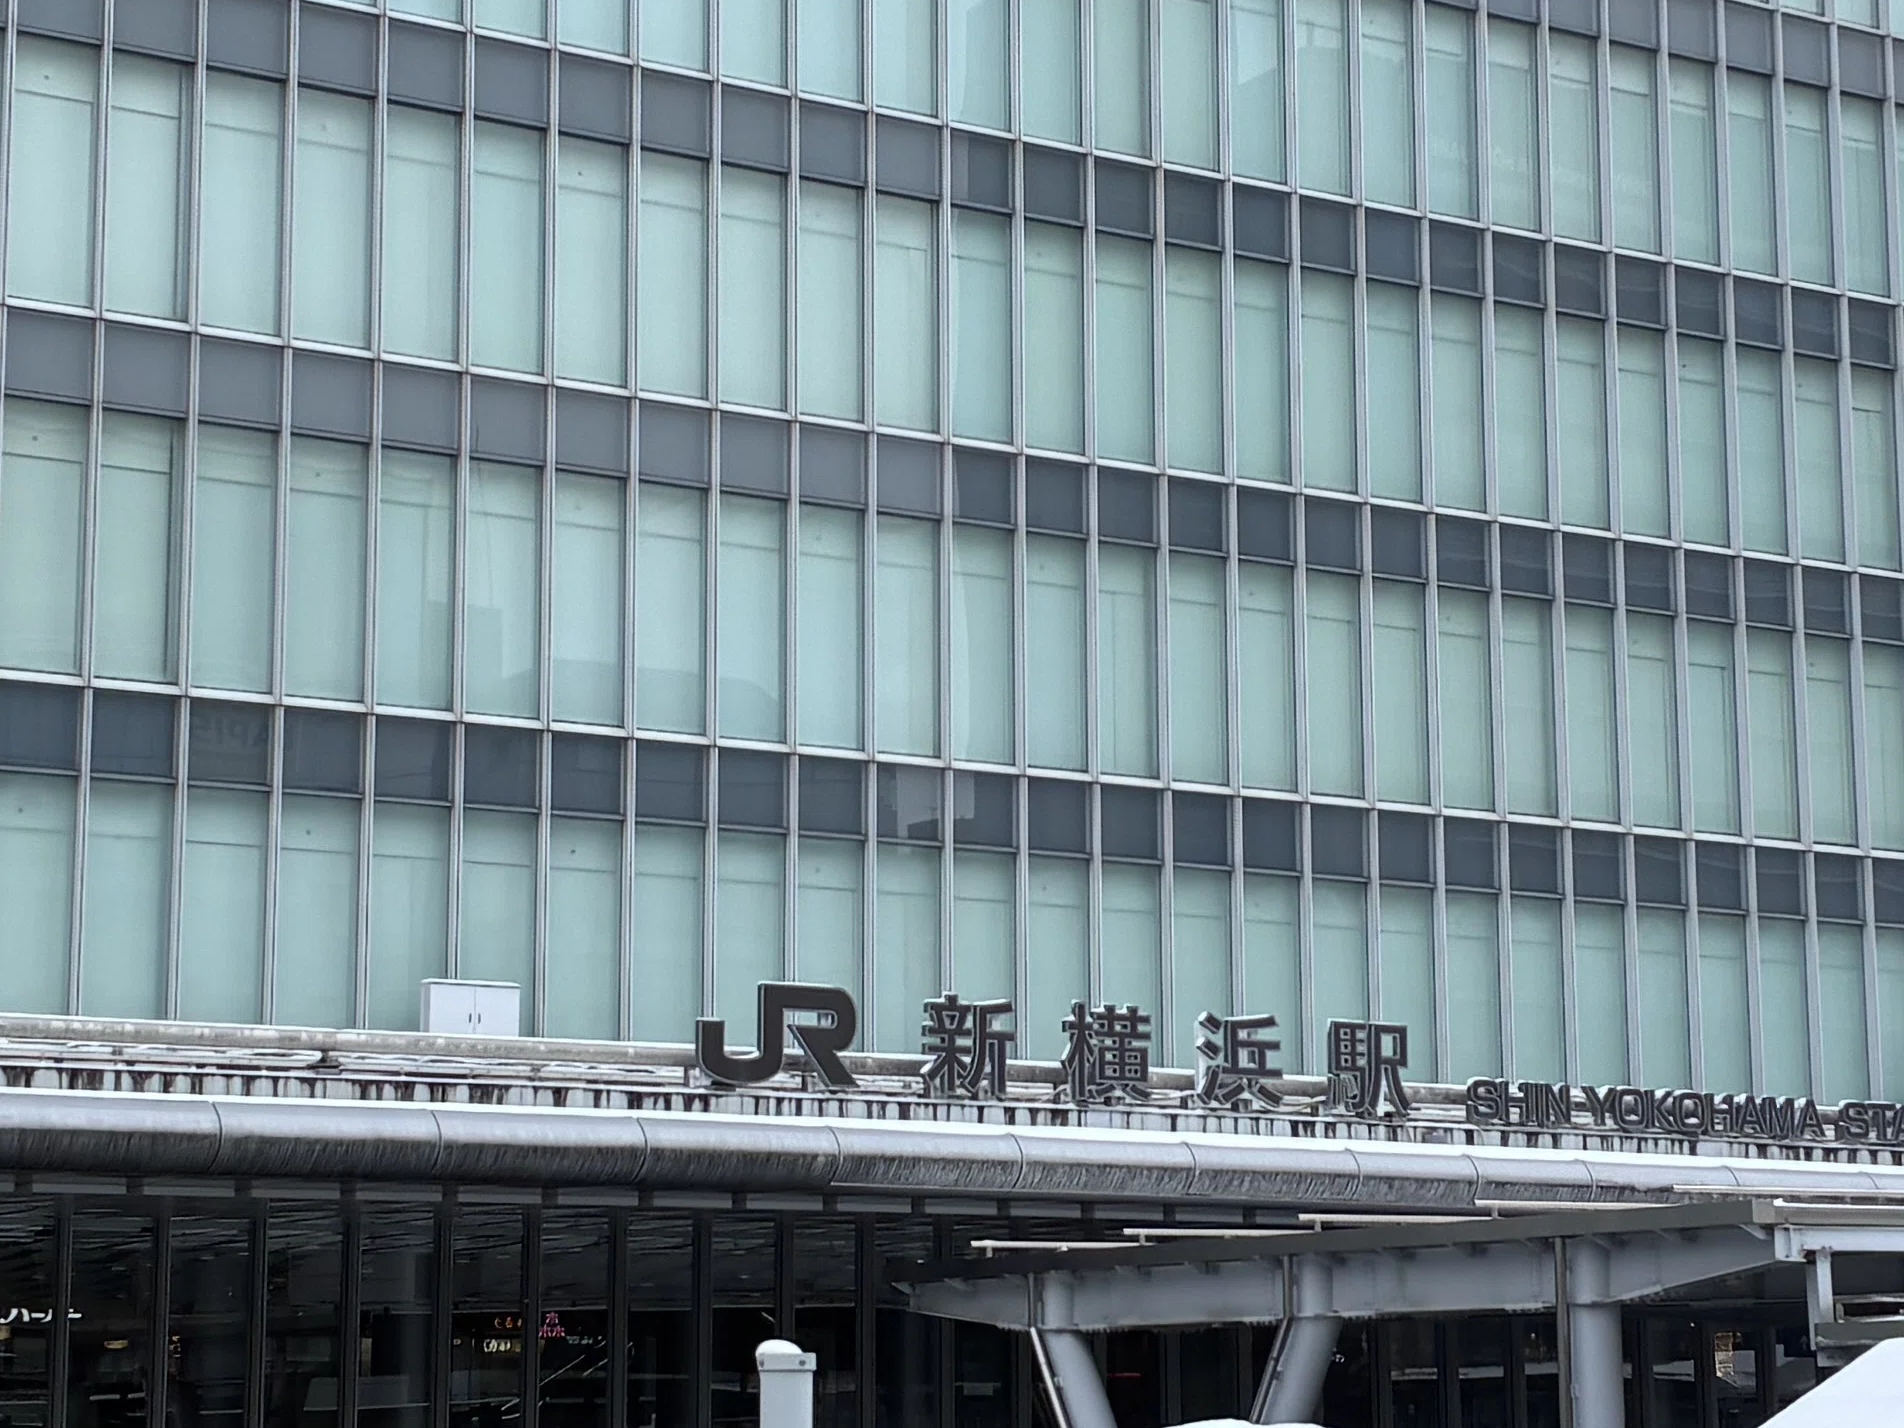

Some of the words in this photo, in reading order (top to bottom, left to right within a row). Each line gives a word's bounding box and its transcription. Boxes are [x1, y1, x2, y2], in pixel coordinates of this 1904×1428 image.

[696, 980, 858, 1090] JR
[921, 990, 1413, 1121] 新横浜駅
